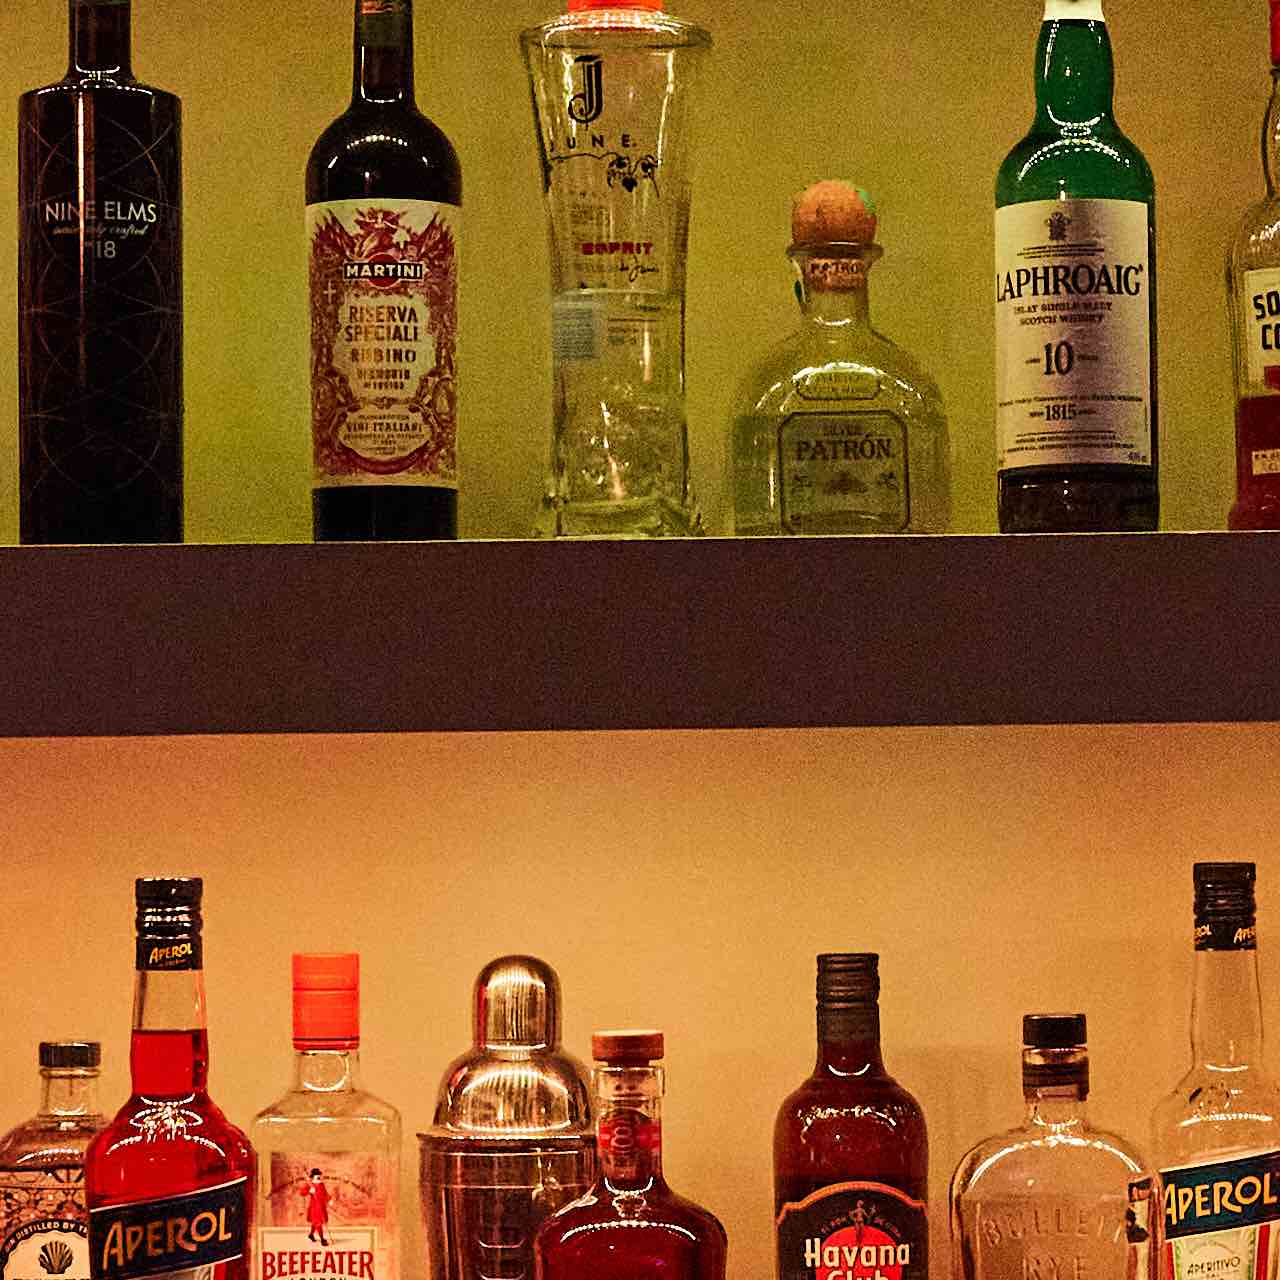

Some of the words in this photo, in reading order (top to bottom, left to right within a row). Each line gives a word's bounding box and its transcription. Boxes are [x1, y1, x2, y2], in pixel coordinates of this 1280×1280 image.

[45, 201, 97, 223] NINE
[104, 200, 158, 223] ELMS
[346, 263, 421, 278] MARTINI
[996, 264, 1144, 303] LAPHROAIG
[349, 305, 418, 323] RISERVA
[351, 348, 417, 362] RUBINO
[1043, 341, 1074, 376] 10
[1044, 404, 1077, 421] 1815
[148, 942, 193, 965] APEROL
[1164, 1171, 1278, 1227] APEROL
[101, 1207, 233, 1271] APEROL
[804, 1237, 910, 1268] Havana
[261, 1250, 375, 1280] BEEFEATER
[1186, 1256, 1241, 1278] APERITIVO
